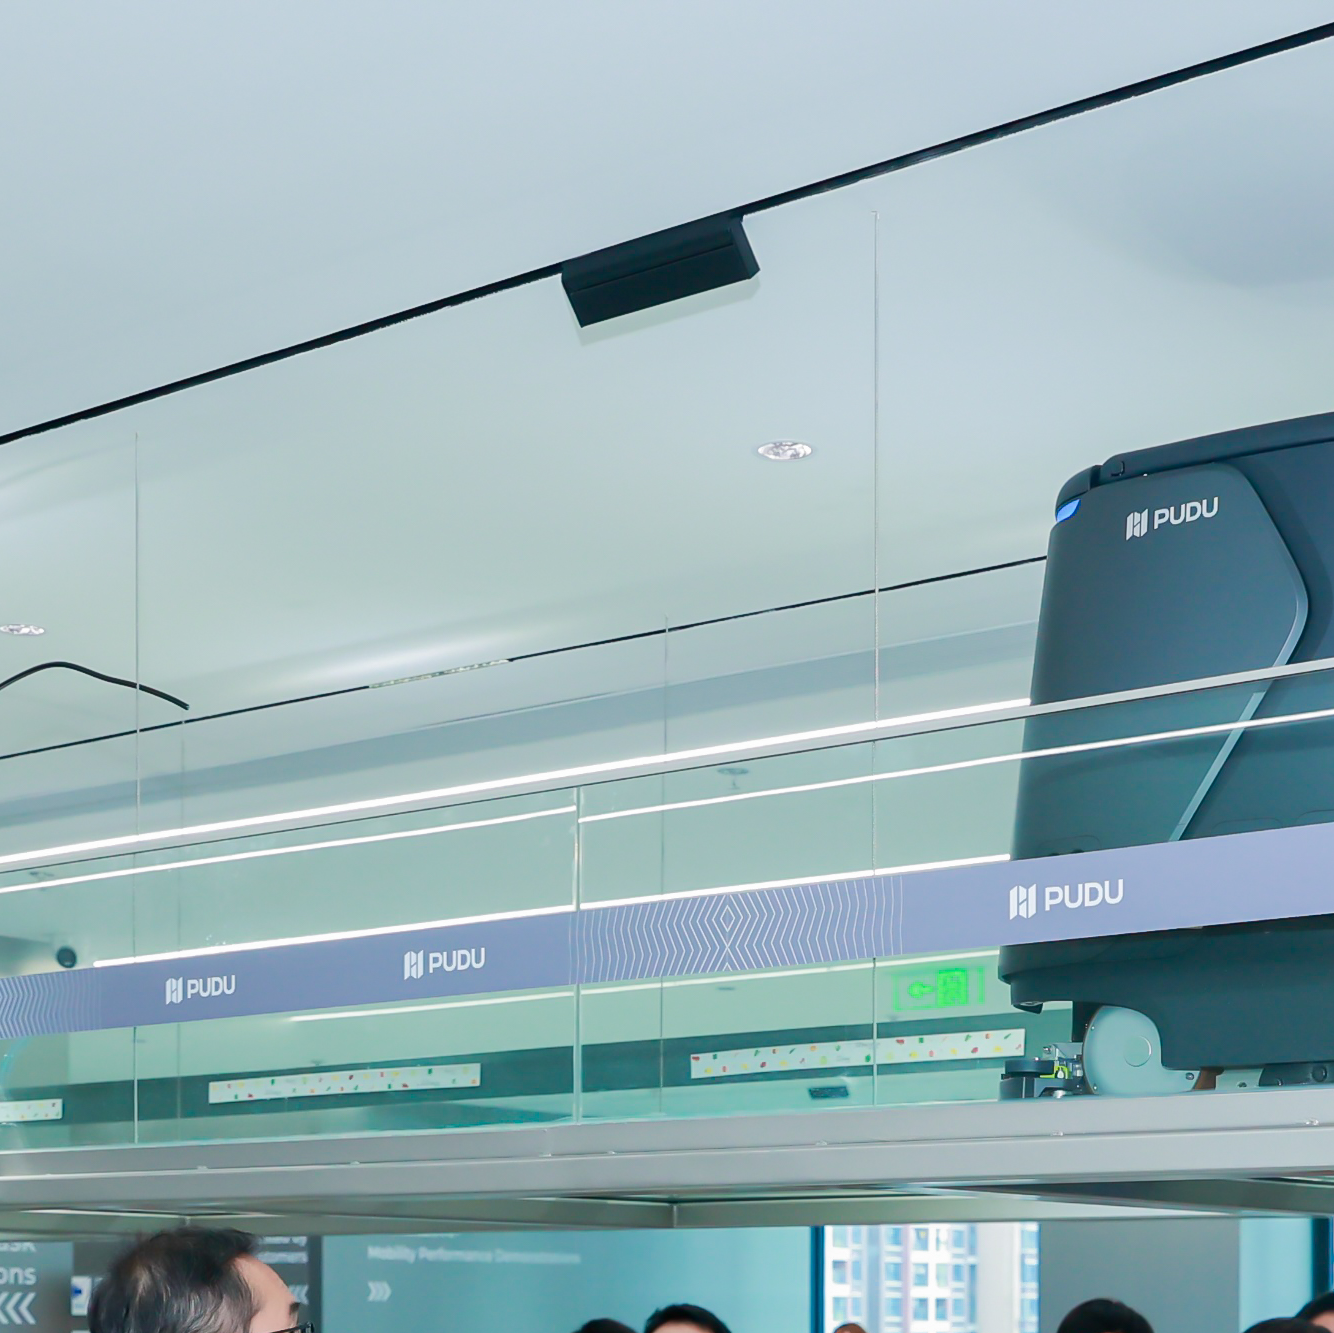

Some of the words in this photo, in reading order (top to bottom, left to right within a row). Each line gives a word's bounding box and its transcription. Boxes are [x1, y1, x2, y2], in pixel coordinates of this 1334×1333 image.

[1153, 496, 1219, 530] PUDU
[1044, 878, 1124, 911] PUDU
[429, 947, 486, 974] PUDU
[187, 974, 236, 999] PUDU
